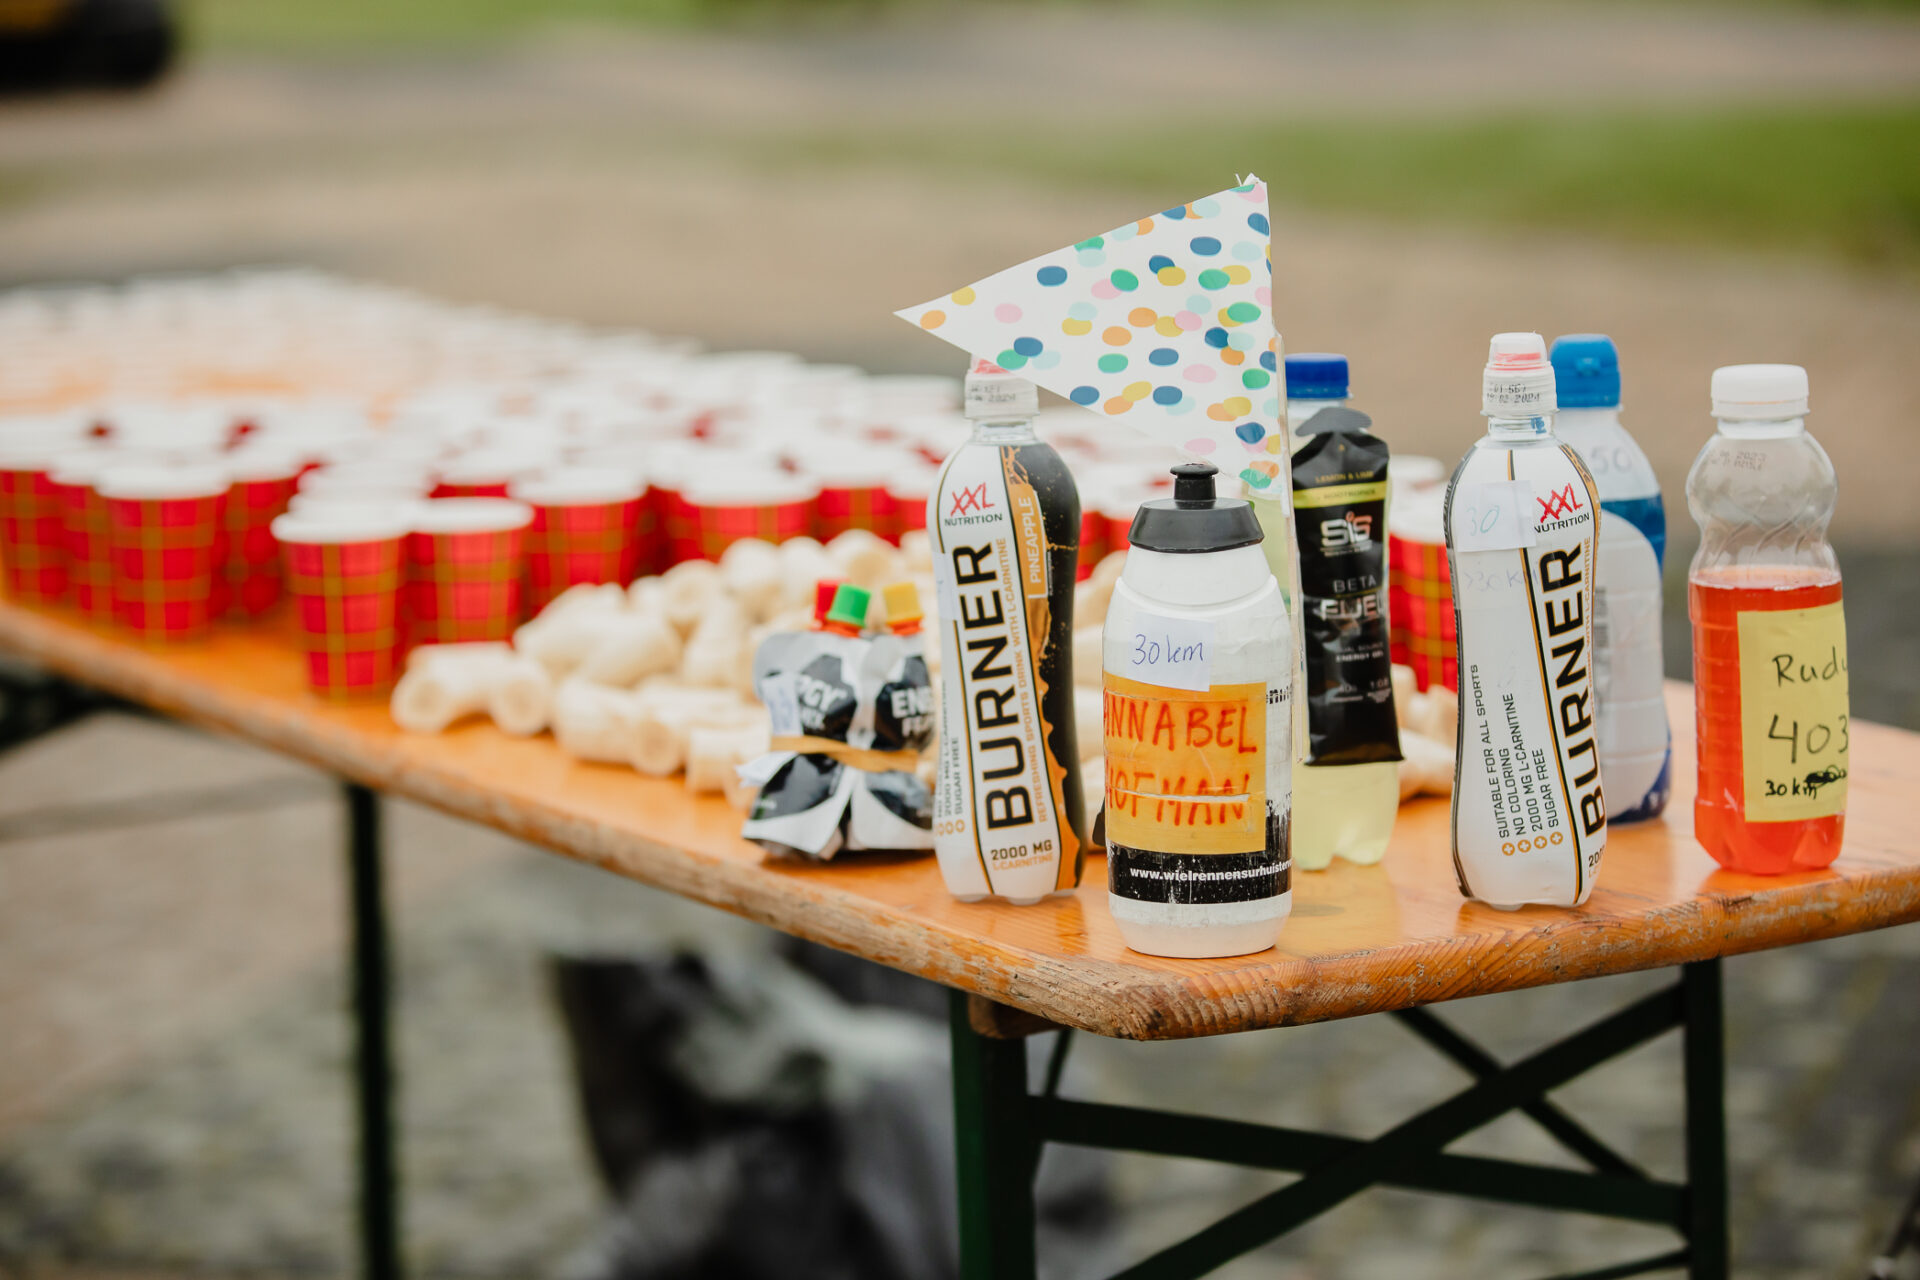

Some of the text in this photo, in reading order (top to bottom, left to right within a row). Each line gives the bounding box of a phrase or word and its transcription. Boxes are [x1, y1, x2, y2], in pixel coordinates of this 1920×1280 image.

[944, 513, 1003, 526] NUTRITION
[950, 481, 995, 516] XXL
[1465, 504, 1501, 537] 30
[1534, 512, 1590, 534] NUTRITION
[1536, 482, 1584, 524] XXL
[1018, 495, 1042, 584] PINEAPPLE
[1333, 574, 1377, 593] BETA
[952, 541, 1035, 831] BURNER
[996, 537, 1048, 823] REFRESHING SPORTS DRINK WITH L-CARNITINE
[1538, 541, 1608, 838] BURNER
[1470, 664, 1510, 838] SUITABLE FOR ALL SPORTS
[1502, 693, 1543, 832] 2000 MG L-CARNITINE
[1768, 713, 1848, 764] 403
[1499, 748, 1526, 836] NO COLORING
[1532, 748, 1559, 828] SUGAR FREE
[990, 839, 1053, 861] 2000 MG
[992, 853, 1053, 871] L-CARNITINE
